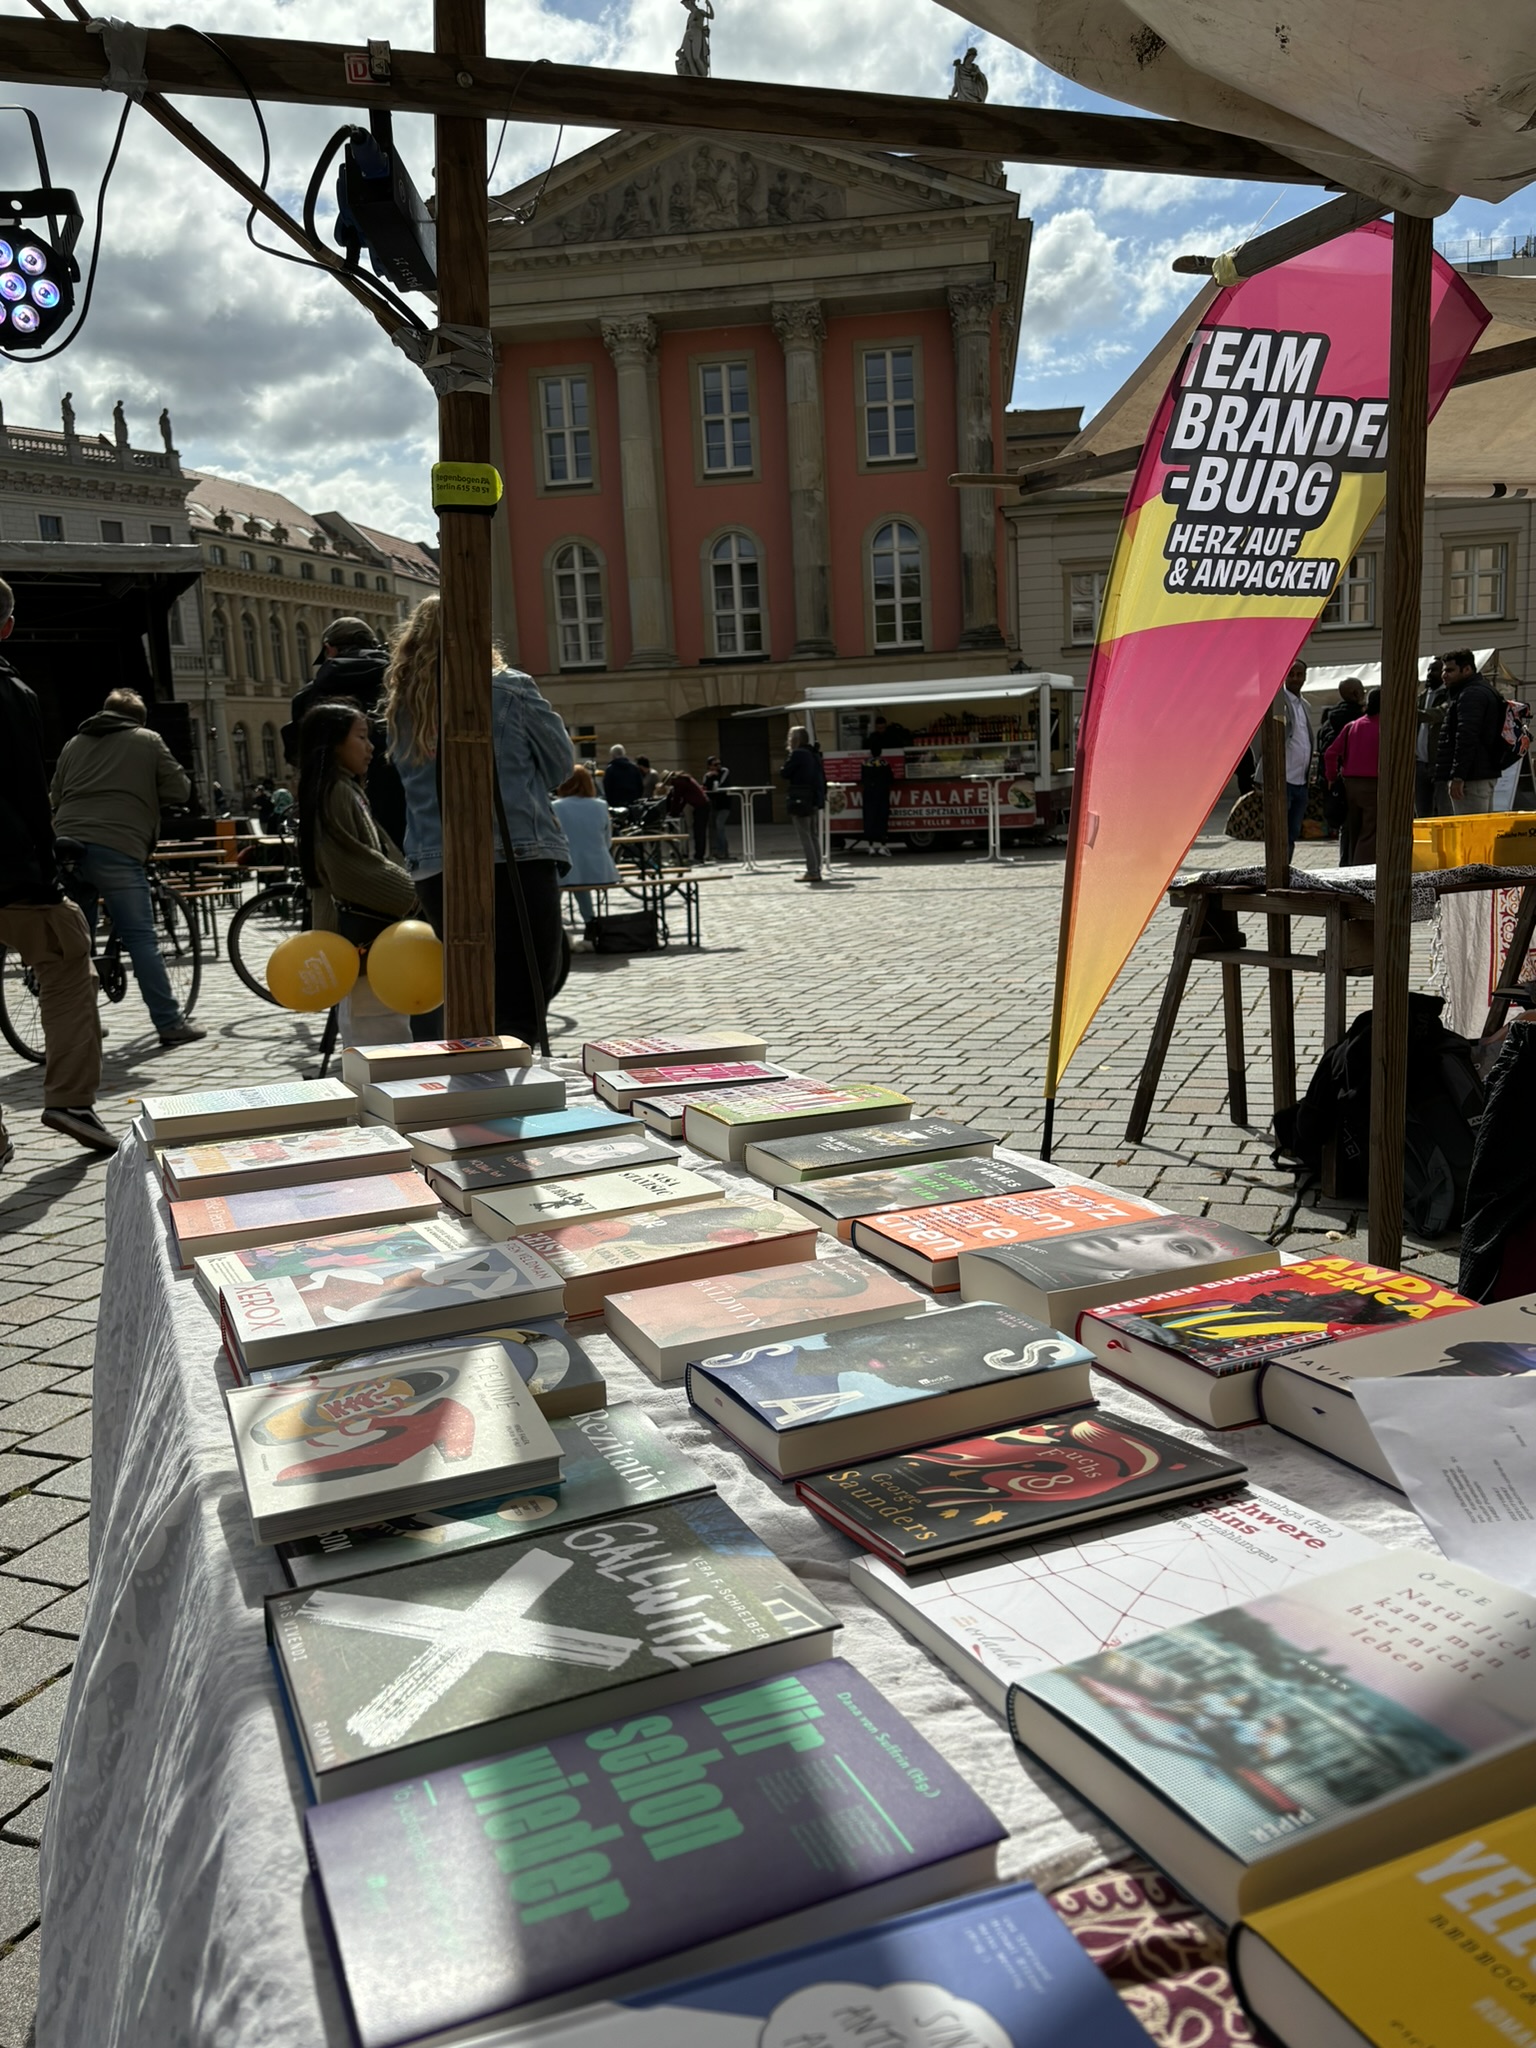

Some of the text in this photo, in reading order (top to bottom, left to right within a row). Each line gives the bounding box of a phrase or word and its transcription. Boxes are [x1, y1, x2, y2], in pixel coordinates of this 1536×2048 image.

[1180, 330, 1322, 394] TEAM
[1171, 393, 1388, 458] BRANDE
[1170, 456, 1333, 516] -BURG
[1169, 524, 1300, 556] HERZ AUF
[1169, 558, 1336, 589] & ANPACKEN
[851, 790, 901, 806] WW
[964, 1167, 1035, 1187] POMMES
[517, 1251, 552, 1280] VELDMAN
[1313, 1256, 1473, 1309] ANDY
[233, 1282, 286, 1333] XEROX
[684, 1279, 773, 1328] BALDWIN
[1093, 1268, 1282, 1315] STEPHEN BUORO
[1282, 1264, 1433, 1320] AFRICA
[471, 1354, 522, 1412] FREUNDE
[569, 1408, 667, 1491] Rezitativ
[1036, 1447, 1104, 1480] Fuchs
[826, 1469, 939, 1542] Saunders
[869, 1472, 922, 1506] George
[1199, 1519, 1278, 1564] Erzählungen
[1304, 1517, 1343, 1539] (Hg.)
[563, 1522, 735, 1672] GALLWITZ
[691, 1555, 717, 1590] VERA
[1418, 1571, 1492, 1607] ÖZGE
[276, 1600, 305, 1662] ARS VIVENDI
[1346, 1604, 1485, 1681] hier nicht
[1350, 1627, 1424, 1673] leben
[1374, 1597, 1504, 1669] kann man
[1396, 1588, 1531, 1661] Natürlich
[1297, 1658, 1351, 1692] ROMAN
[311, 1720, 339, 1764] ROMAN
[702, 1677, 826, 1756] Wir
[836, 1691, 942, 1800] Dana von Suffrin (Hg.)
[585, 1715, 744, 1862] schon
[460, 1747, 633, 1927] wieder
[1249, 1806, 1317, 1844] PIPER
